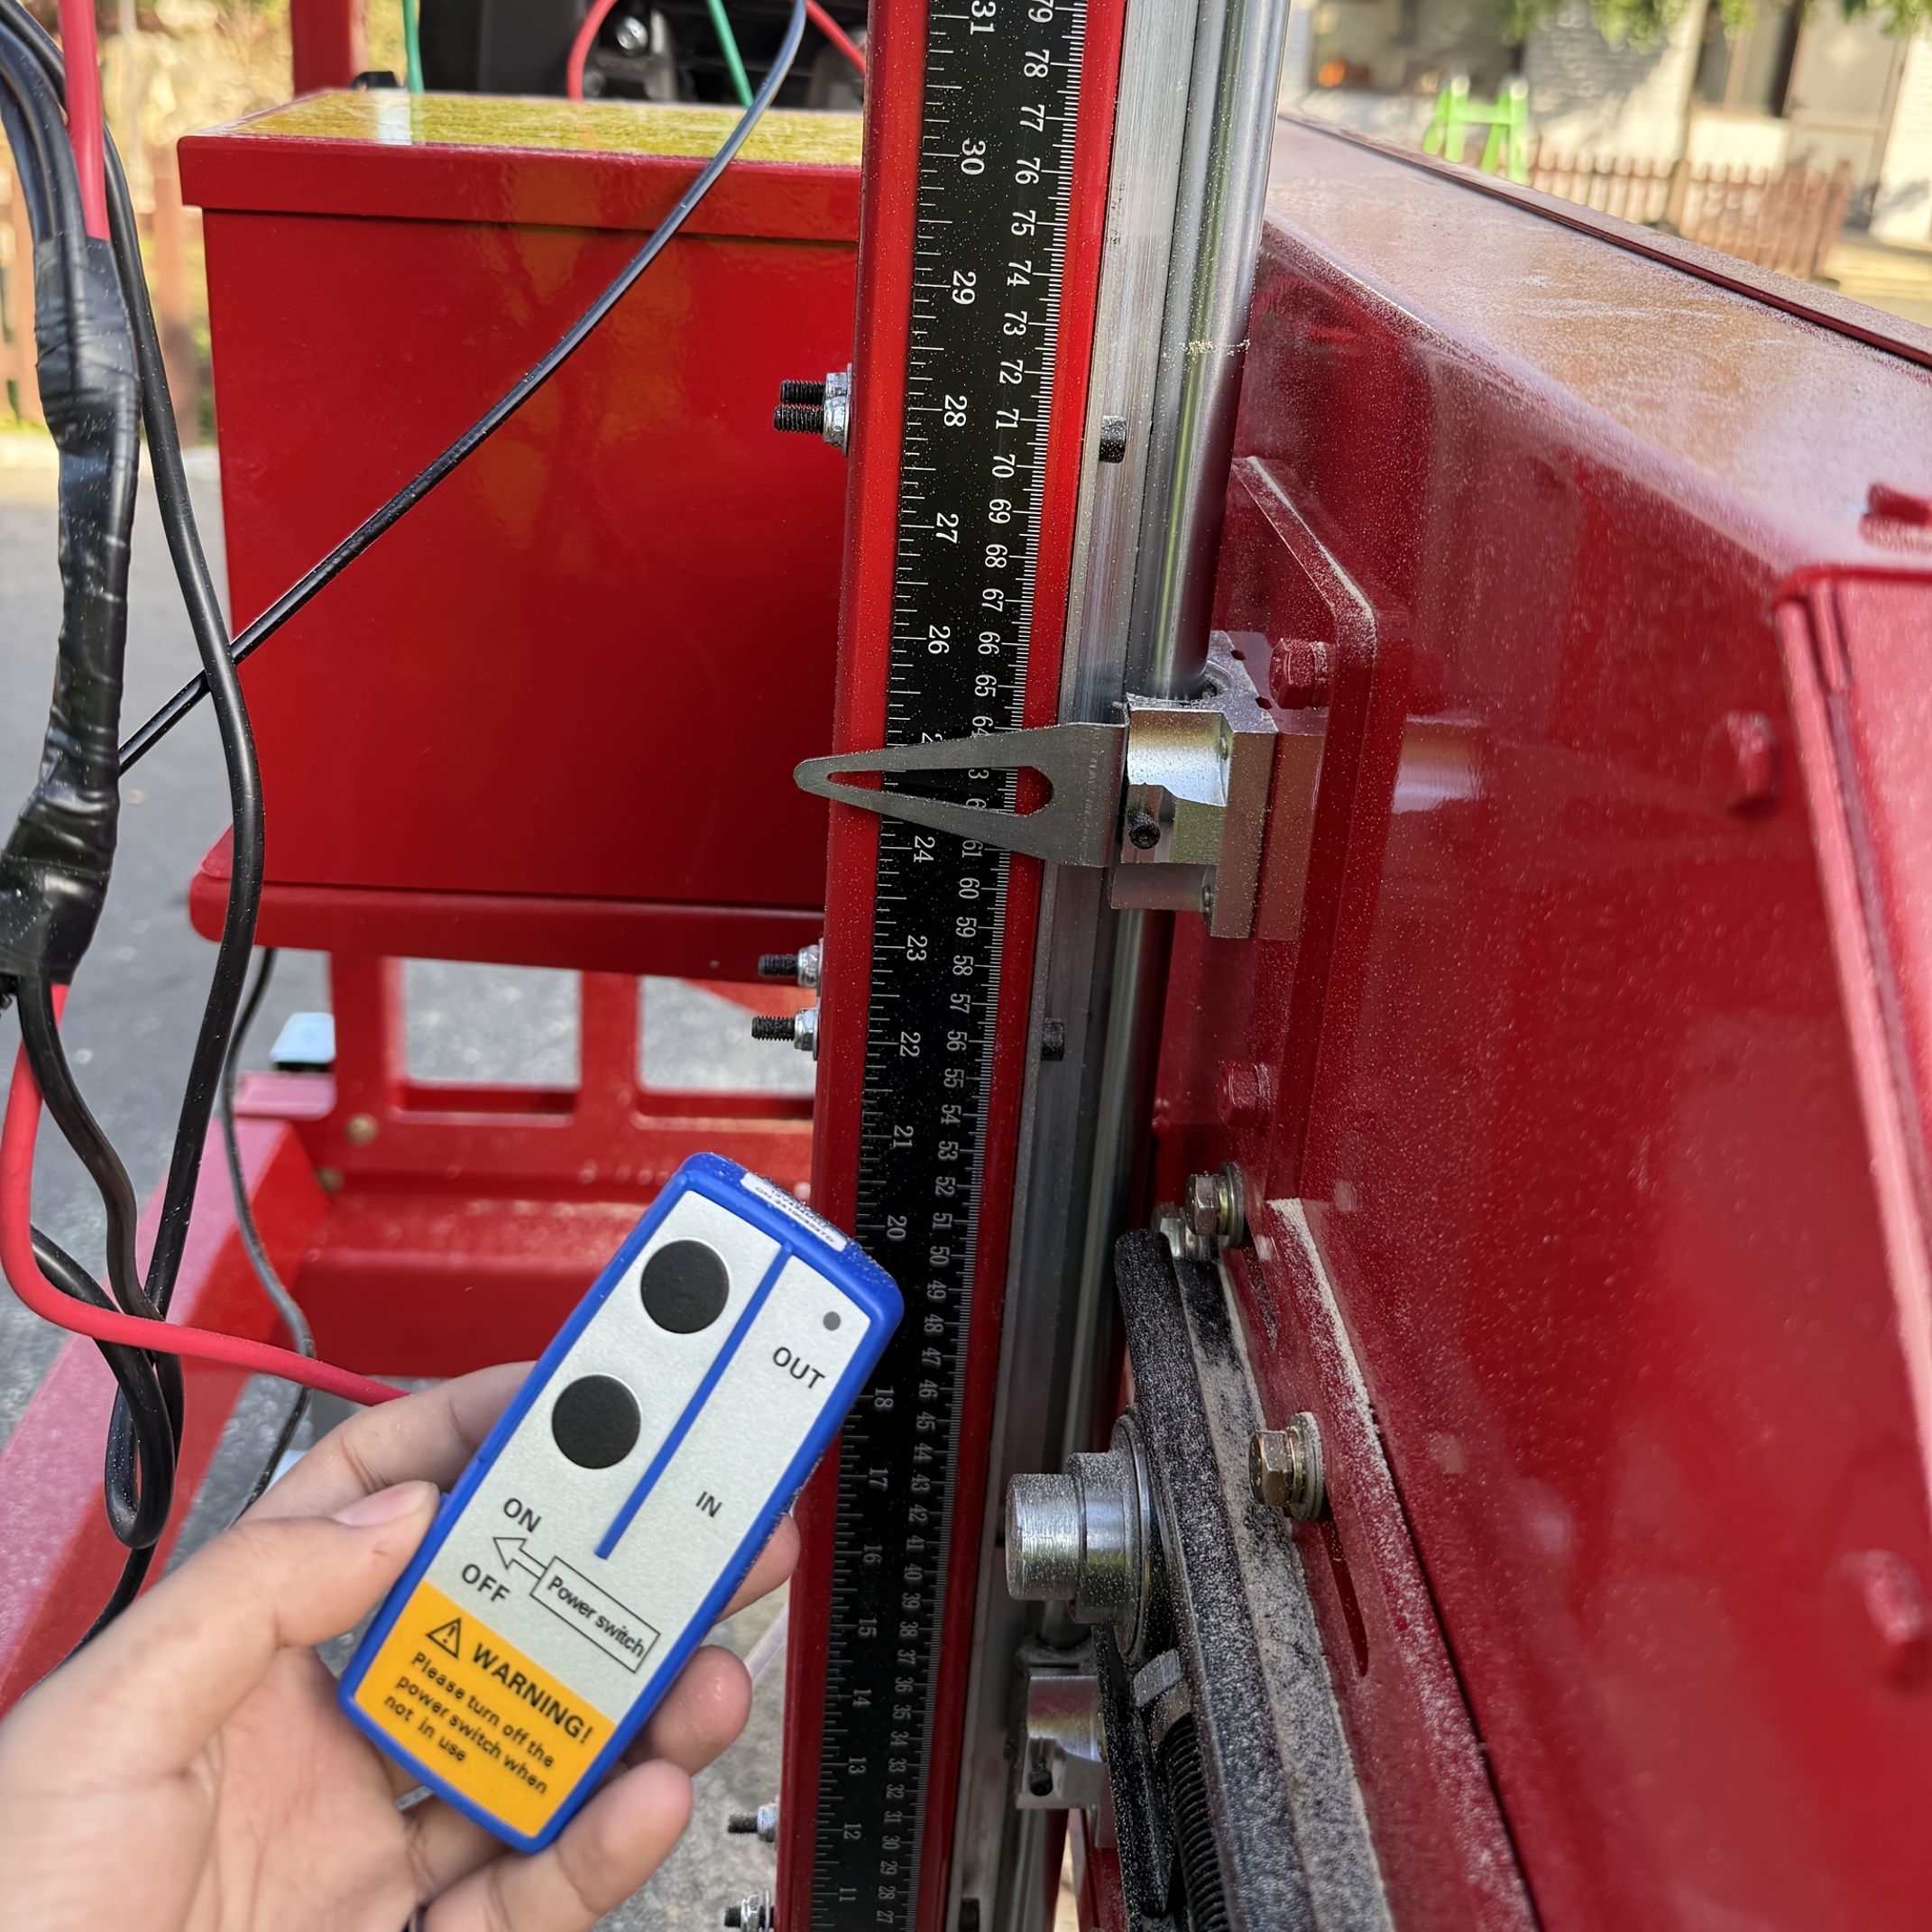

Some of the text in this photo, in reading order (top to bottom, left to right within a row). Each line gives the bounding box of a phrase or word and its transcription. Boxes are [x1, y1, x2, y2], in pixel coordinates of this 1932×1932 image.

[1028, 0, 1053, 23] 79
[1024, 50, 1049, 78] 78
[1020, 104, 1044, 132] 77
[1015, 157, 1041, 185] 76
[1011, 209, 1036, 236] 75
[1007, 260, 1032, 287] 74
[1003, 311, 1027, 336] 73
[999, 359, 1024, 384] 72
[996, 409, 1019, 429] 71
[992, 454, 1016, 478] 70
[989, 499, 1012, 524] 69
[985, 544, 1007, 568] 68
[981, 588, 1005, 612] 67
[978, 631, 1001, 655] 66
[974, 674, 997, 697] 65
[961, 839, 983, 858] 61
[959, 878, 980, 899] 60
[955, 916, 977, 938] 59
[839, 0, 996, 1902] 31 30 29 28 27 26 24 23 22 21 20 18 17 16 15 14 13 12 11
[952, 954, 974, 976] 58
[950, 993, 971, 1014] 57
[947, 1030, 968, 1052] 56
[943, 1068, 965, 1088] 55
[941, 1104, 962, 1125] 54
[937, 1140, 959, 1161] 53
[934, 1176, 956, 1197] 52
[932, 1212, 953, 1230] 51
[929, 1246, 951, 1267] 50
[926, 1280, 947, 1302] 49
[924, 1313, 944, 1336] 48
[921, 1347, 942, 1367] 47
[773, 1347, 825, 1389] OUT
[919, 1379, 938, 1401] 46
[916, 1412, 936, 1432] 45
[914, 1442, 934, 1462] 44
[911, 1474, 931, 1493] 43
[503, 1497, 541, 1533] ON
[695, 1491, 722, 1518] IN
[908, 1504, 928, 1524] 42
[906, 1535, 925, 1551] 41
[461, 1563, 511, 1602] OFF
[904, 1563, 923, 1581] 40
[902, 1593, 921, 1609] 39
[547, 1575, 645, 1658] Power switch
[899, 1621, 918, 1638] 38
[897, 1649, 916, 1665] 37
[472, 1642, 593, 1743] WARNING!
[895, 1677, 915, 1693] 36
[411, 1651, 555, 1768] Please turn off the
[892, 1704, 912, 1720] 35
[384, 1695, 467, 1762] not in use
[395, 1676, 548, 1795] power switch when
[890, 1731, 909, 1745] 34
[888, 1758, 907, 1773] 33
[886, 1784, 905, 1799] 32
[884, 1810, 902, 1824] 31
[882, 1835, 900, 1850] 30
[880, 1861, 898, 1875] 29
[878, 1885, 897, 1900] 28
[876, 1910, 895, 1924] 27
